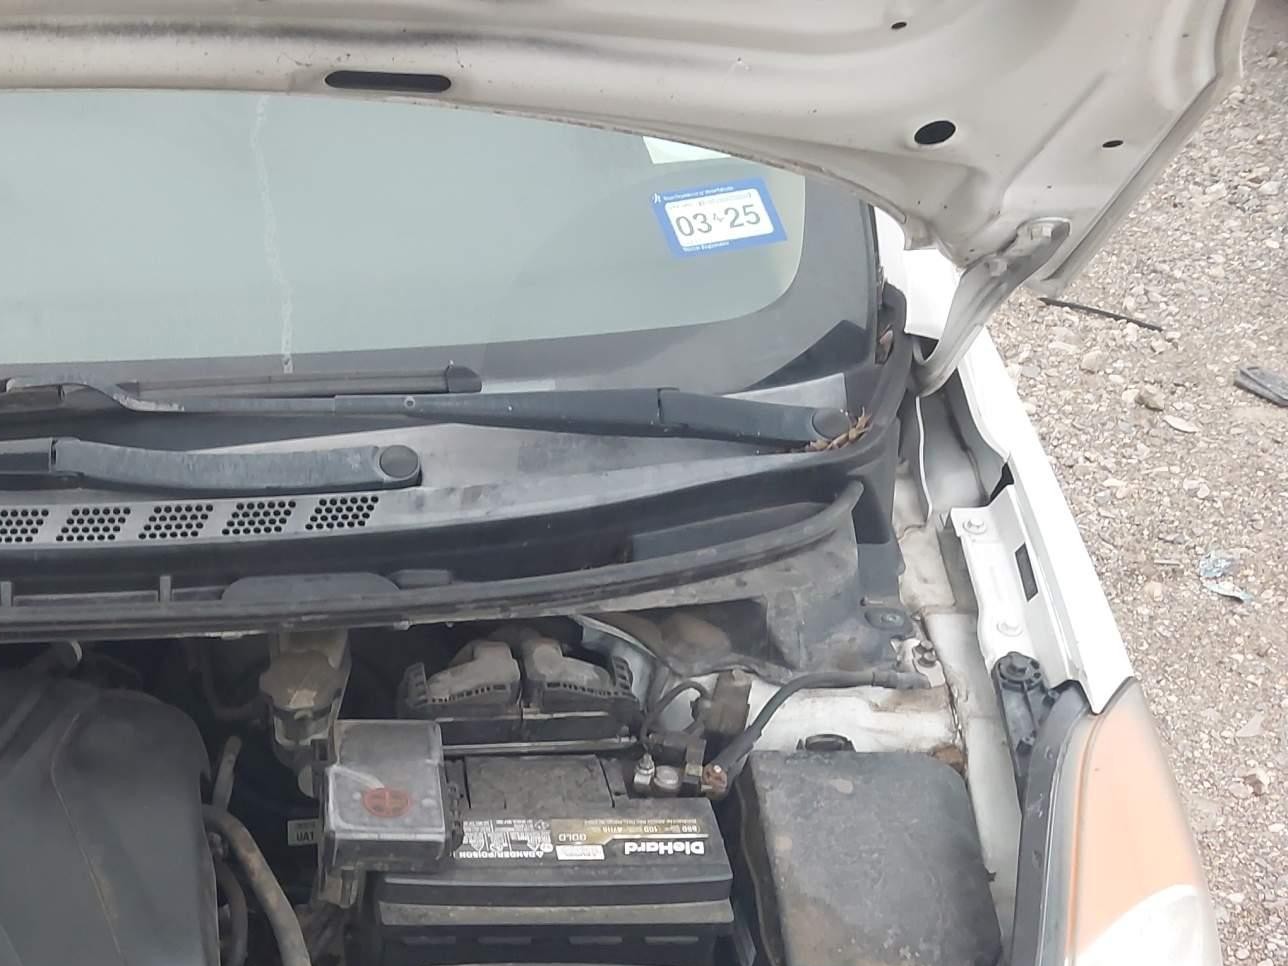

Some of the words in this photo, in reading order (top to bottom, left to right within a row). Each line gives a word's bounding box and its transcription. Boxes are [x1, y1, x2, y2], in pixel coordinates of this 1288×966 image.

[675, 212, 712, 237] 03
[724, 203, 761, 229] 25
[558, 832, 587, 842] GOLD
[624, 841, 705, 855] DieHard
